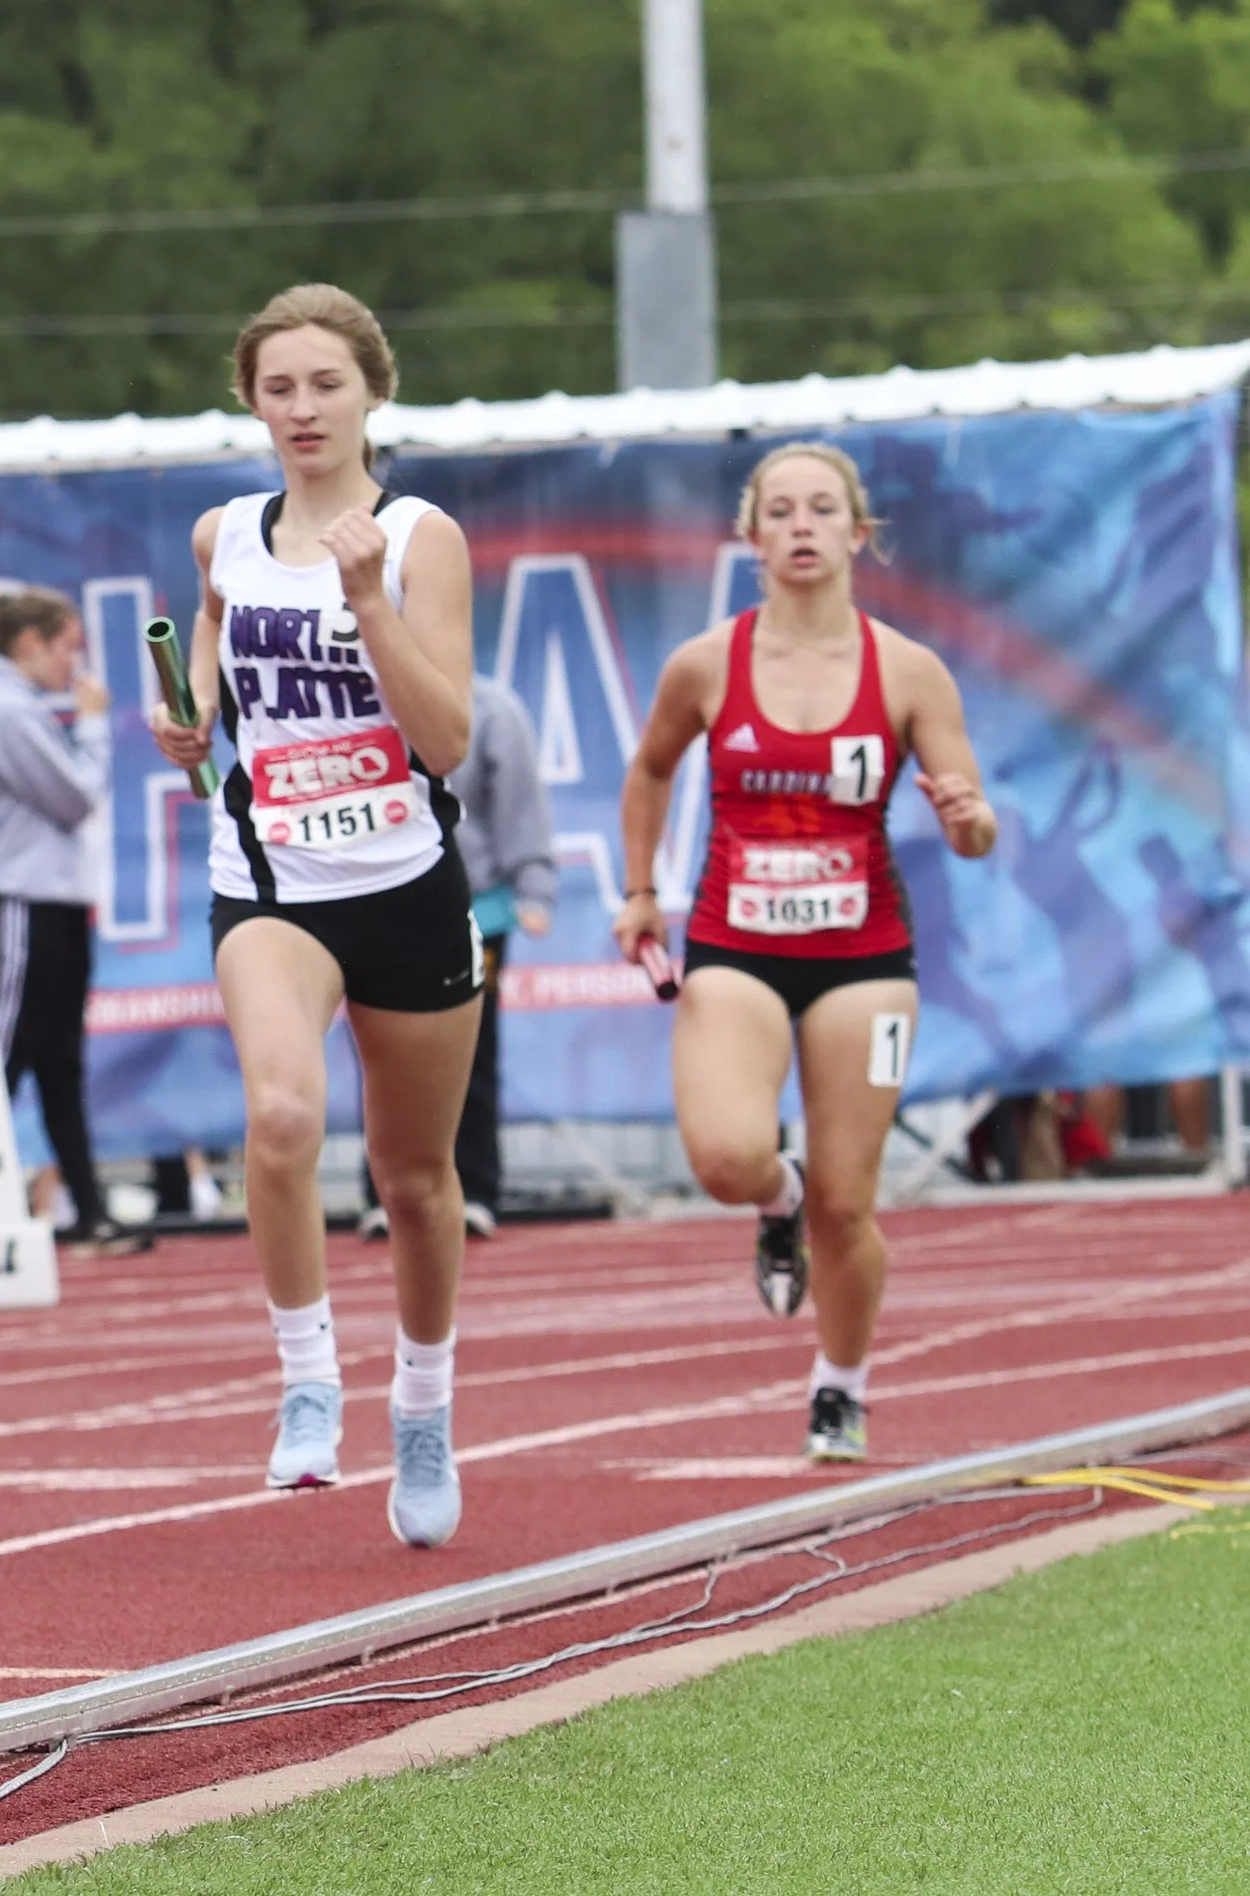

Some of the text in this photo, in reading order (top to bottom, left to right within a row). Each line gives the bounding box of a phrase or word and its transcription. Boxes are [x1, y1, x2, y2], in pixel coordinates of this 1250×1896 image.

[263, 746, 390, 799] ZERO
[850, 744, 867, 799] 1
[301, 802, 375, 842] 1151
[742, 848, 854, 882] ZERO
[767, 898, 831, 923] 1031
[885, 1022, 899, 1079] 1
